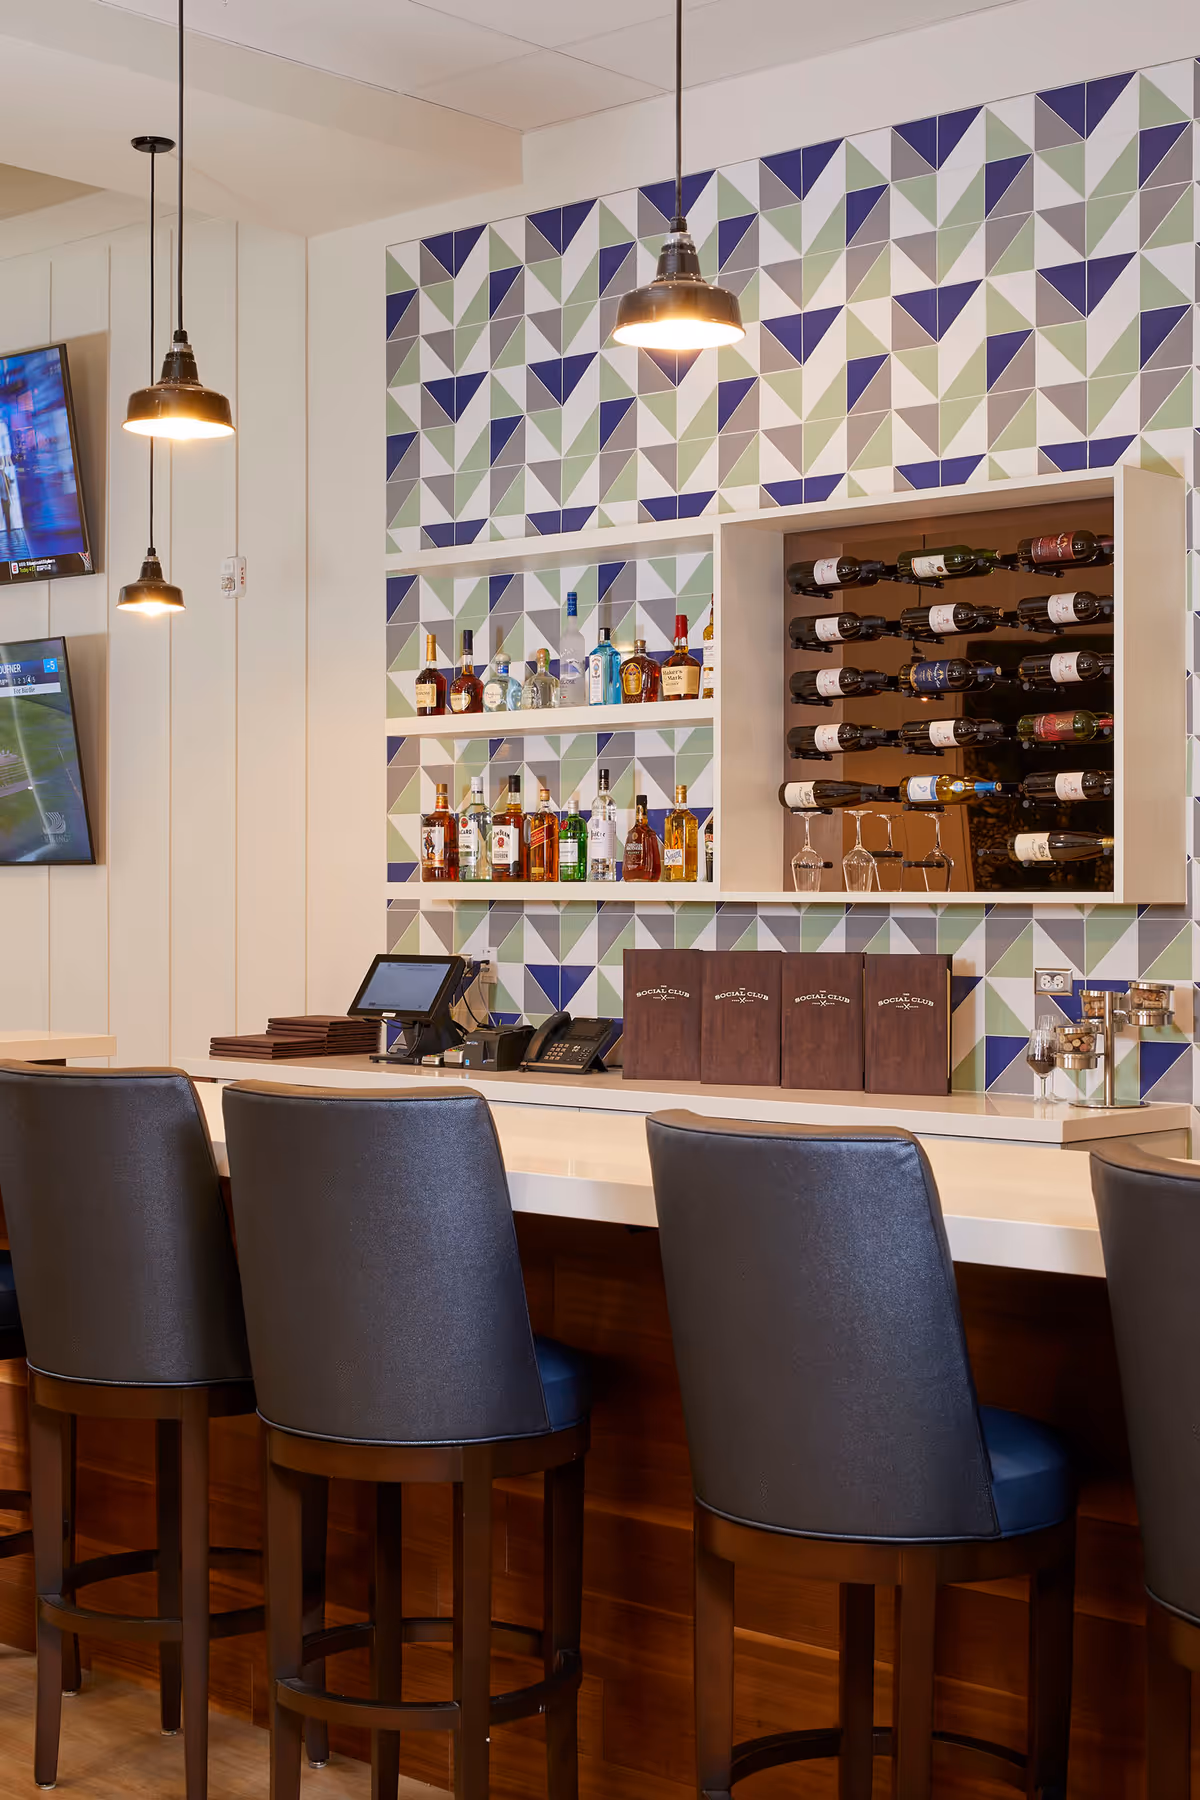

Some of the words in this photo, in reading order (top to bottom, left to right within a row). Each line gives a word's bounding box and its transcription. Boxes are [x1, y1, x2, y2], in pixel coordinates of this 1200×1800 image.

[46, 660, 56, 670] -5
[636, 988, 667, 998] SOCIAL
[668, 989, 690, 998] CLUB
[714, 991, 746, 1001] SOCIAL
[746, 991, 769, 1001] CLUB
[794, 994, 827, 1004] SOCIAL
[827, 994, 850, 1004] CLUB
[877, 996, 910, 1007] SOCIAL
[911, 997, 934, 1007] CLUB
